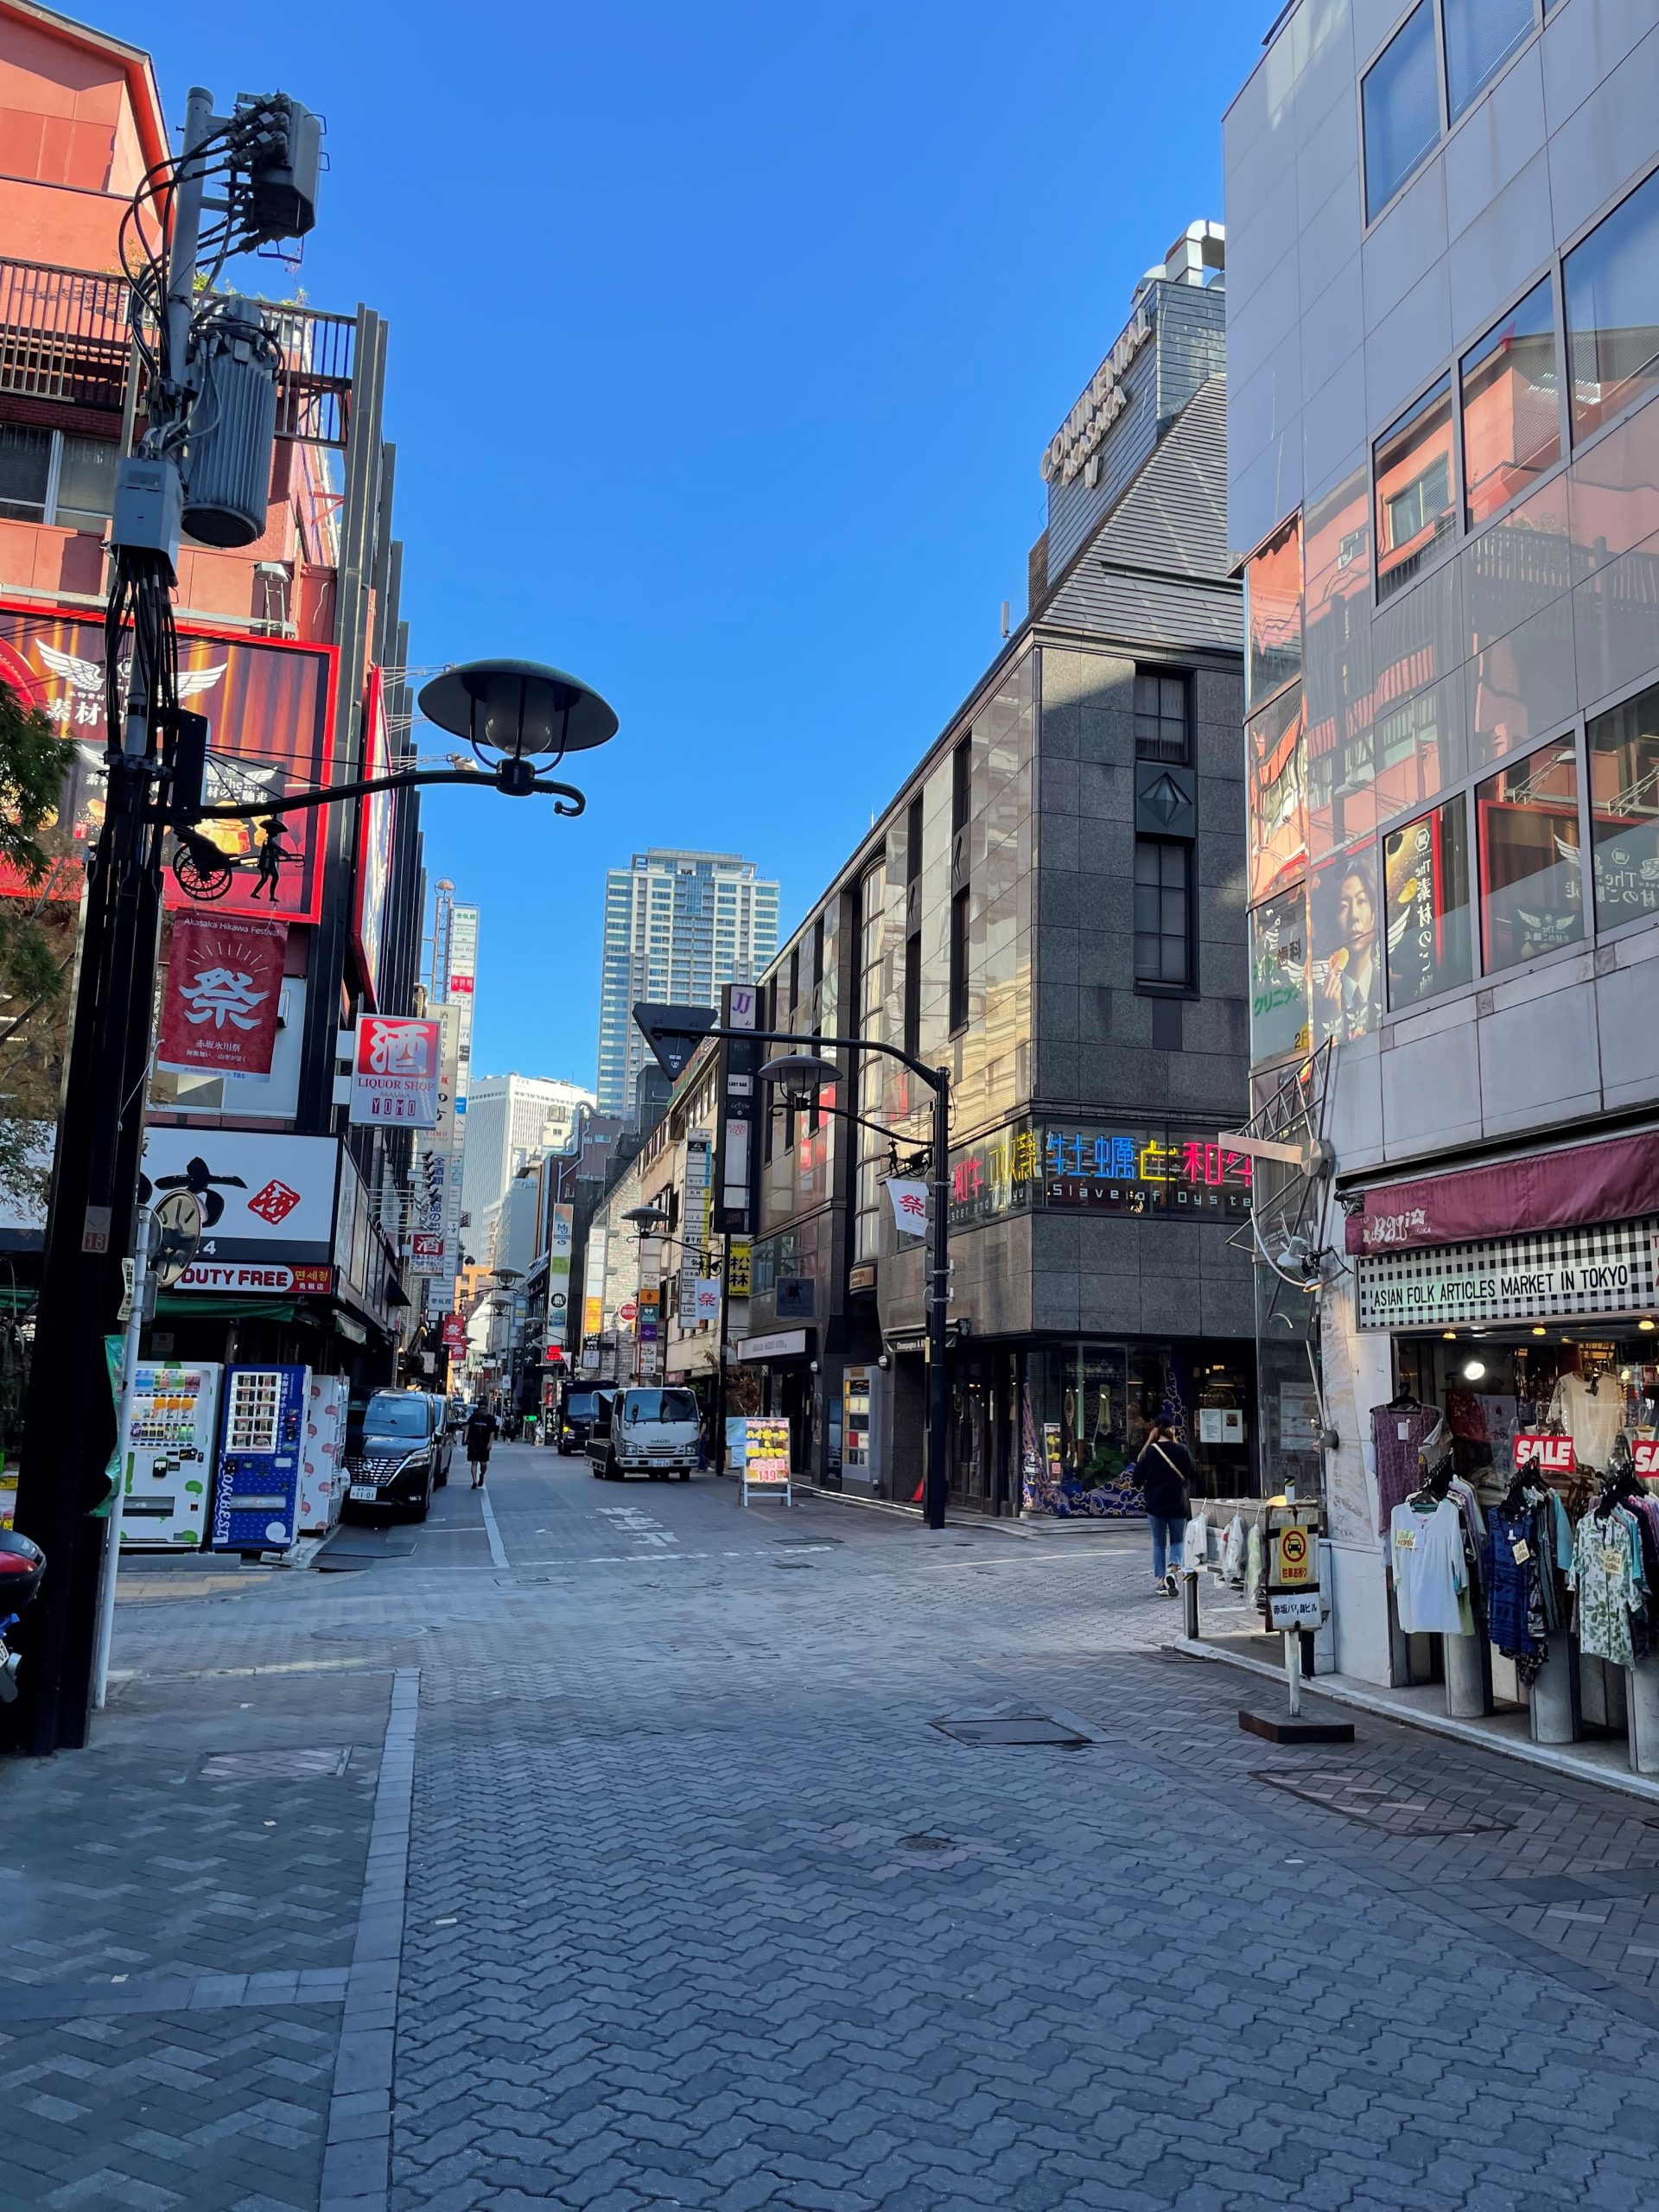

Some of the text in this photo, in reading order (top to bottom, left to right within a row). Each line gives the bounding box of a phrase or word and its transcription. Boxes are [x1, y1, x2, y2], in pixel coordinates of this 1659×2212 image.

[184, 918, 280, 937] Akasaka Hikawa Festival
[178, 966, 270, 1031] 祭
[370, 1020, 429, 1074] 酒
[1294, 1028, 1308, 1049] 2F
[358, 1077, 435, 1092] LIQUOR SHOP
[372, 1098, 416, 1116] YOMO
[1052, 1184, 1119, 1199] Slave
[1136, 1190, 1160, 1202] of
[898, 1194, 925, 1217] 祭
[416, 1236, 440, 1253] 酒
[181, 1268, 288, 1287] DUTY FREE
[295, 1270, 328, 1281] 면세점
[1374, 1264, 1629, 1307] ASIAN FOLK ARTICLES MARKET IN TOKYO
[698, 1292, 716, 1307] 祭
[1516, 1440, 1573, 1466] SALE
[759, 1471, 776, 1481] 149
